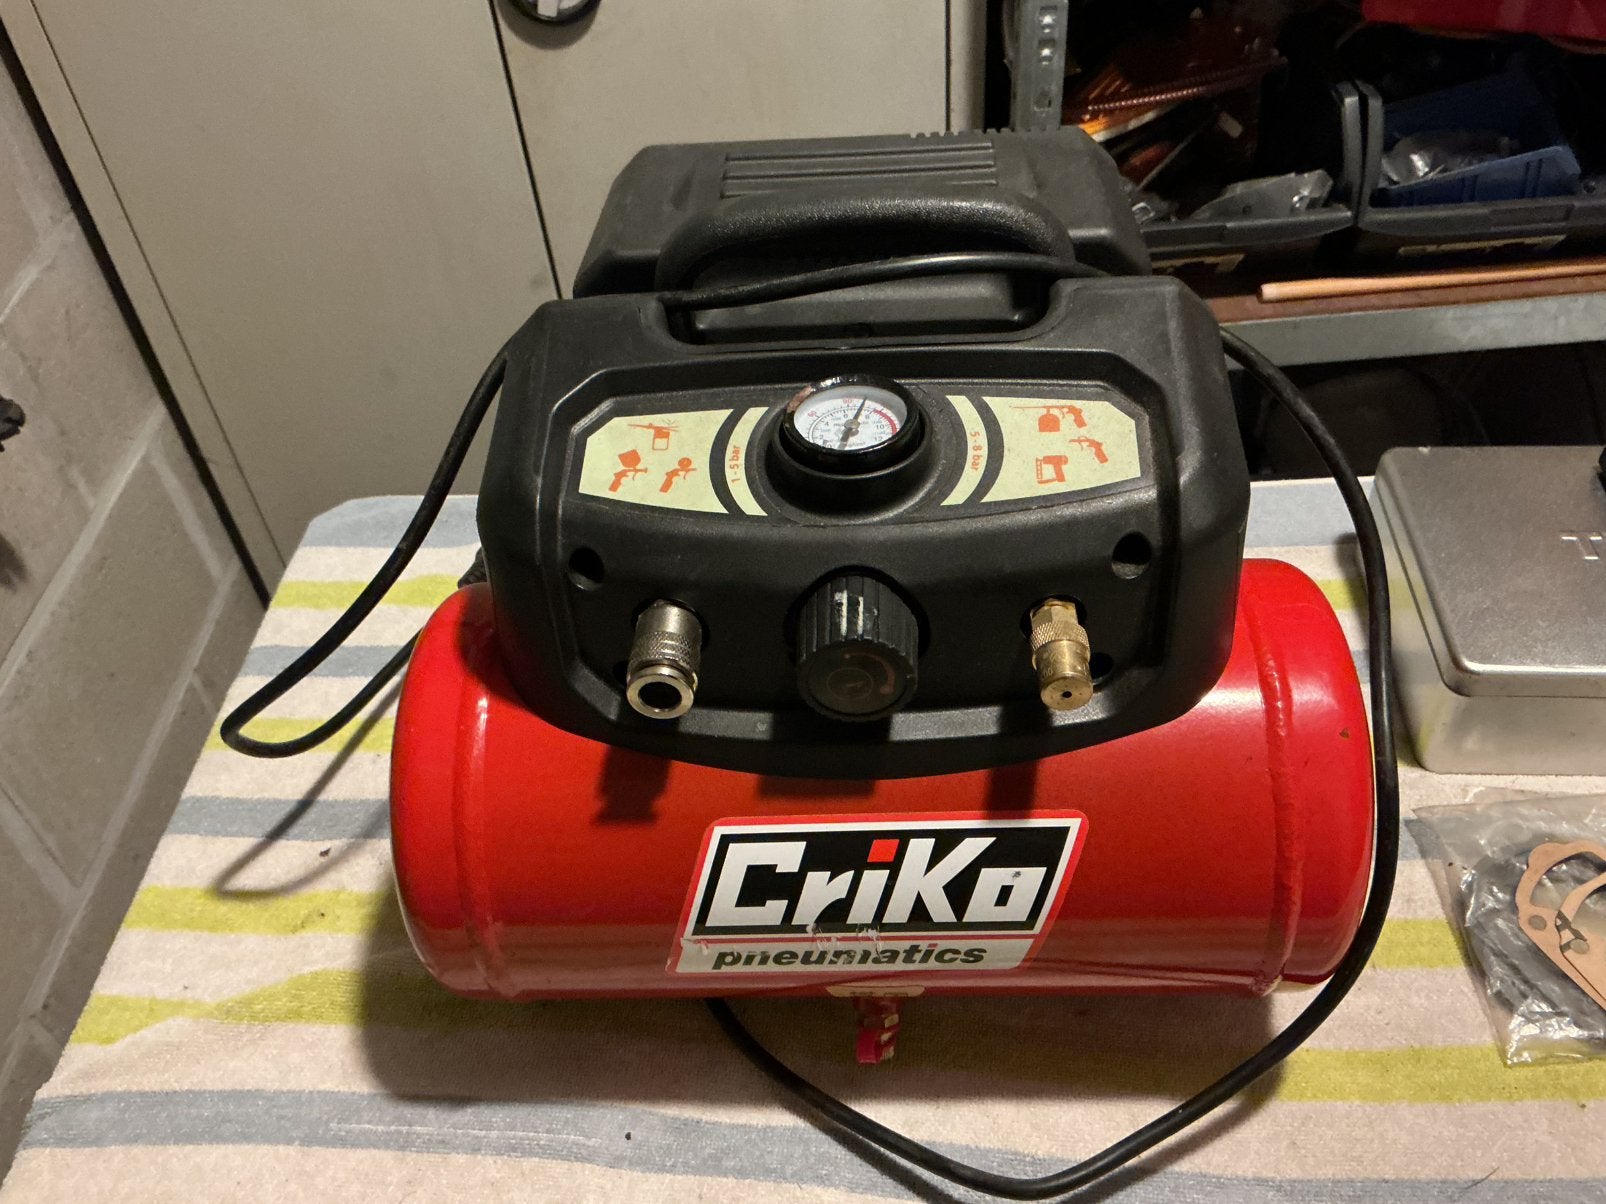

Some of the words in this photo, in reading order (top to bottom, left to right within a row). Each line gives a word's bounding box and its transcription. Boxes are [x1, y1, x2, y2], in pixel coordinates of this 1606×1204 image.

[729, 445, 740, 462] bar
[971, 454, 982, 471] bar
[705, 837, 1047, 927] CriKo
[712, 943, 988, 971] pneumatics
